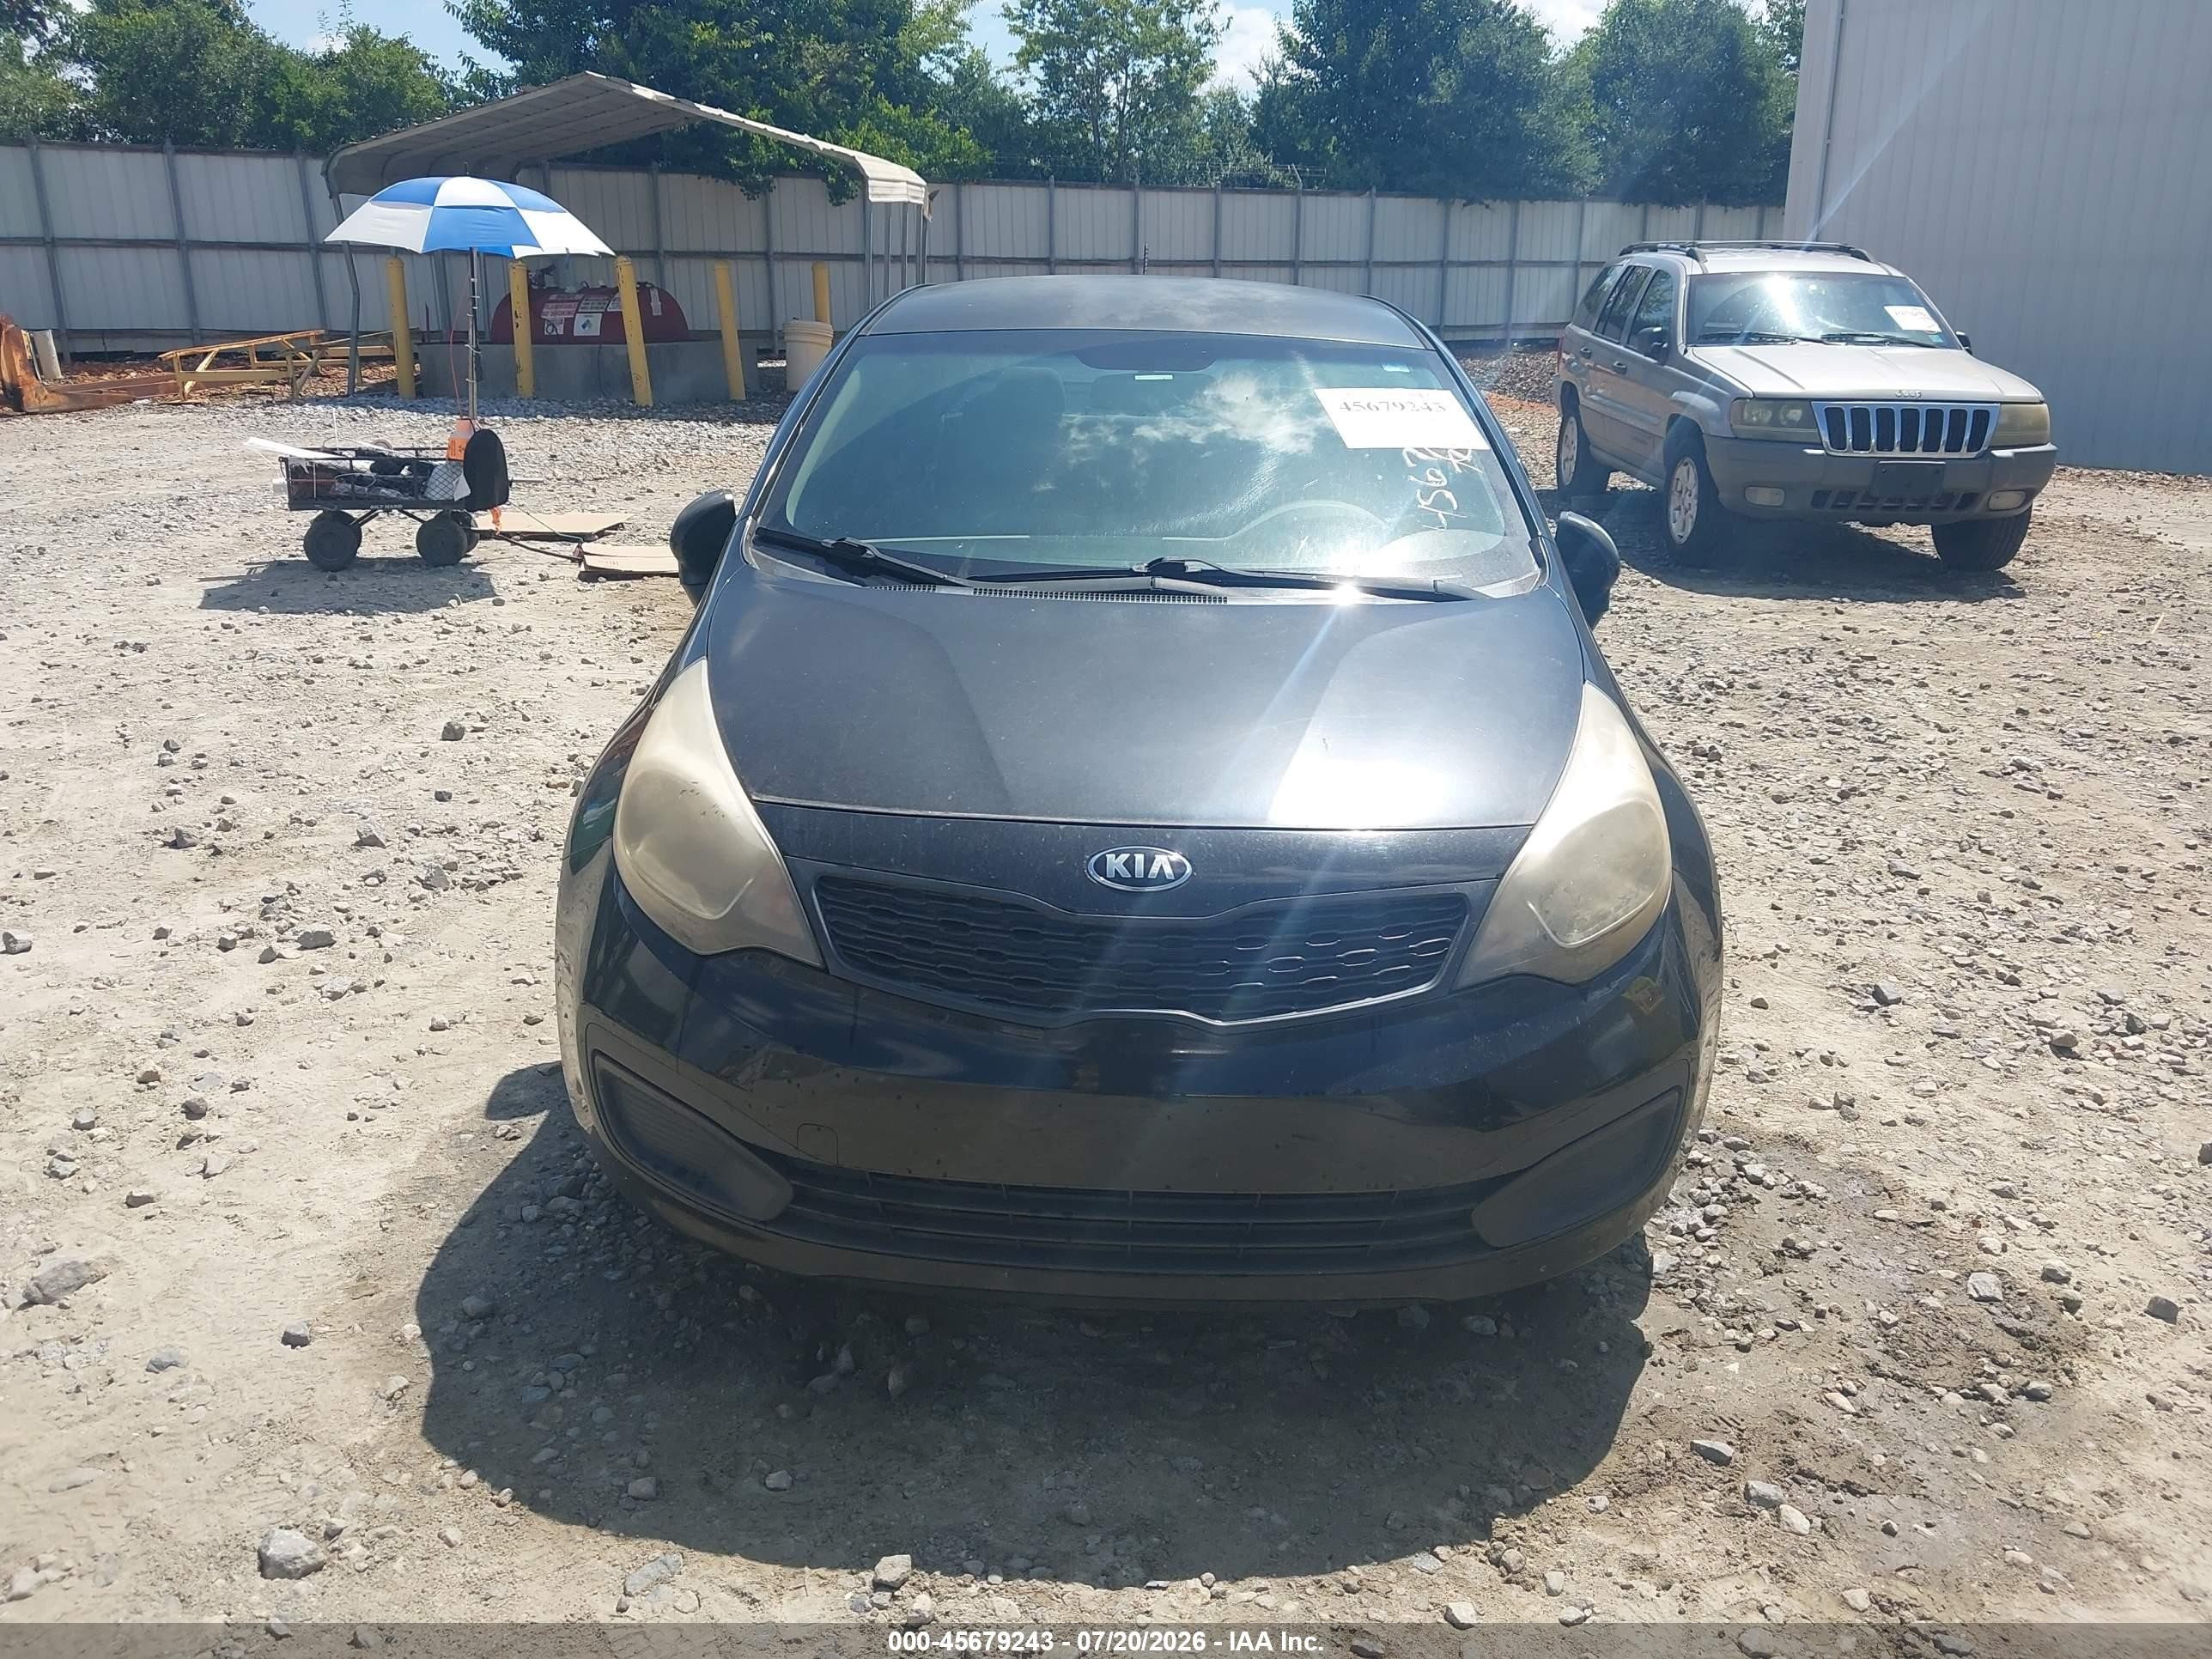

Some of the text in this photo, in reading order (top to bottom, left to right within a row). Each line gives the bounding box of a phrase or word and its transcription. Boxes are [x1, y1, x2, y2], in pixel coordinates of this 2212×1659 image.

[1895, 389, 1923, 399] Jeep
[1339, 401, 1447, 413] 45679243
[1105, 854, 1176, 880] KIA
